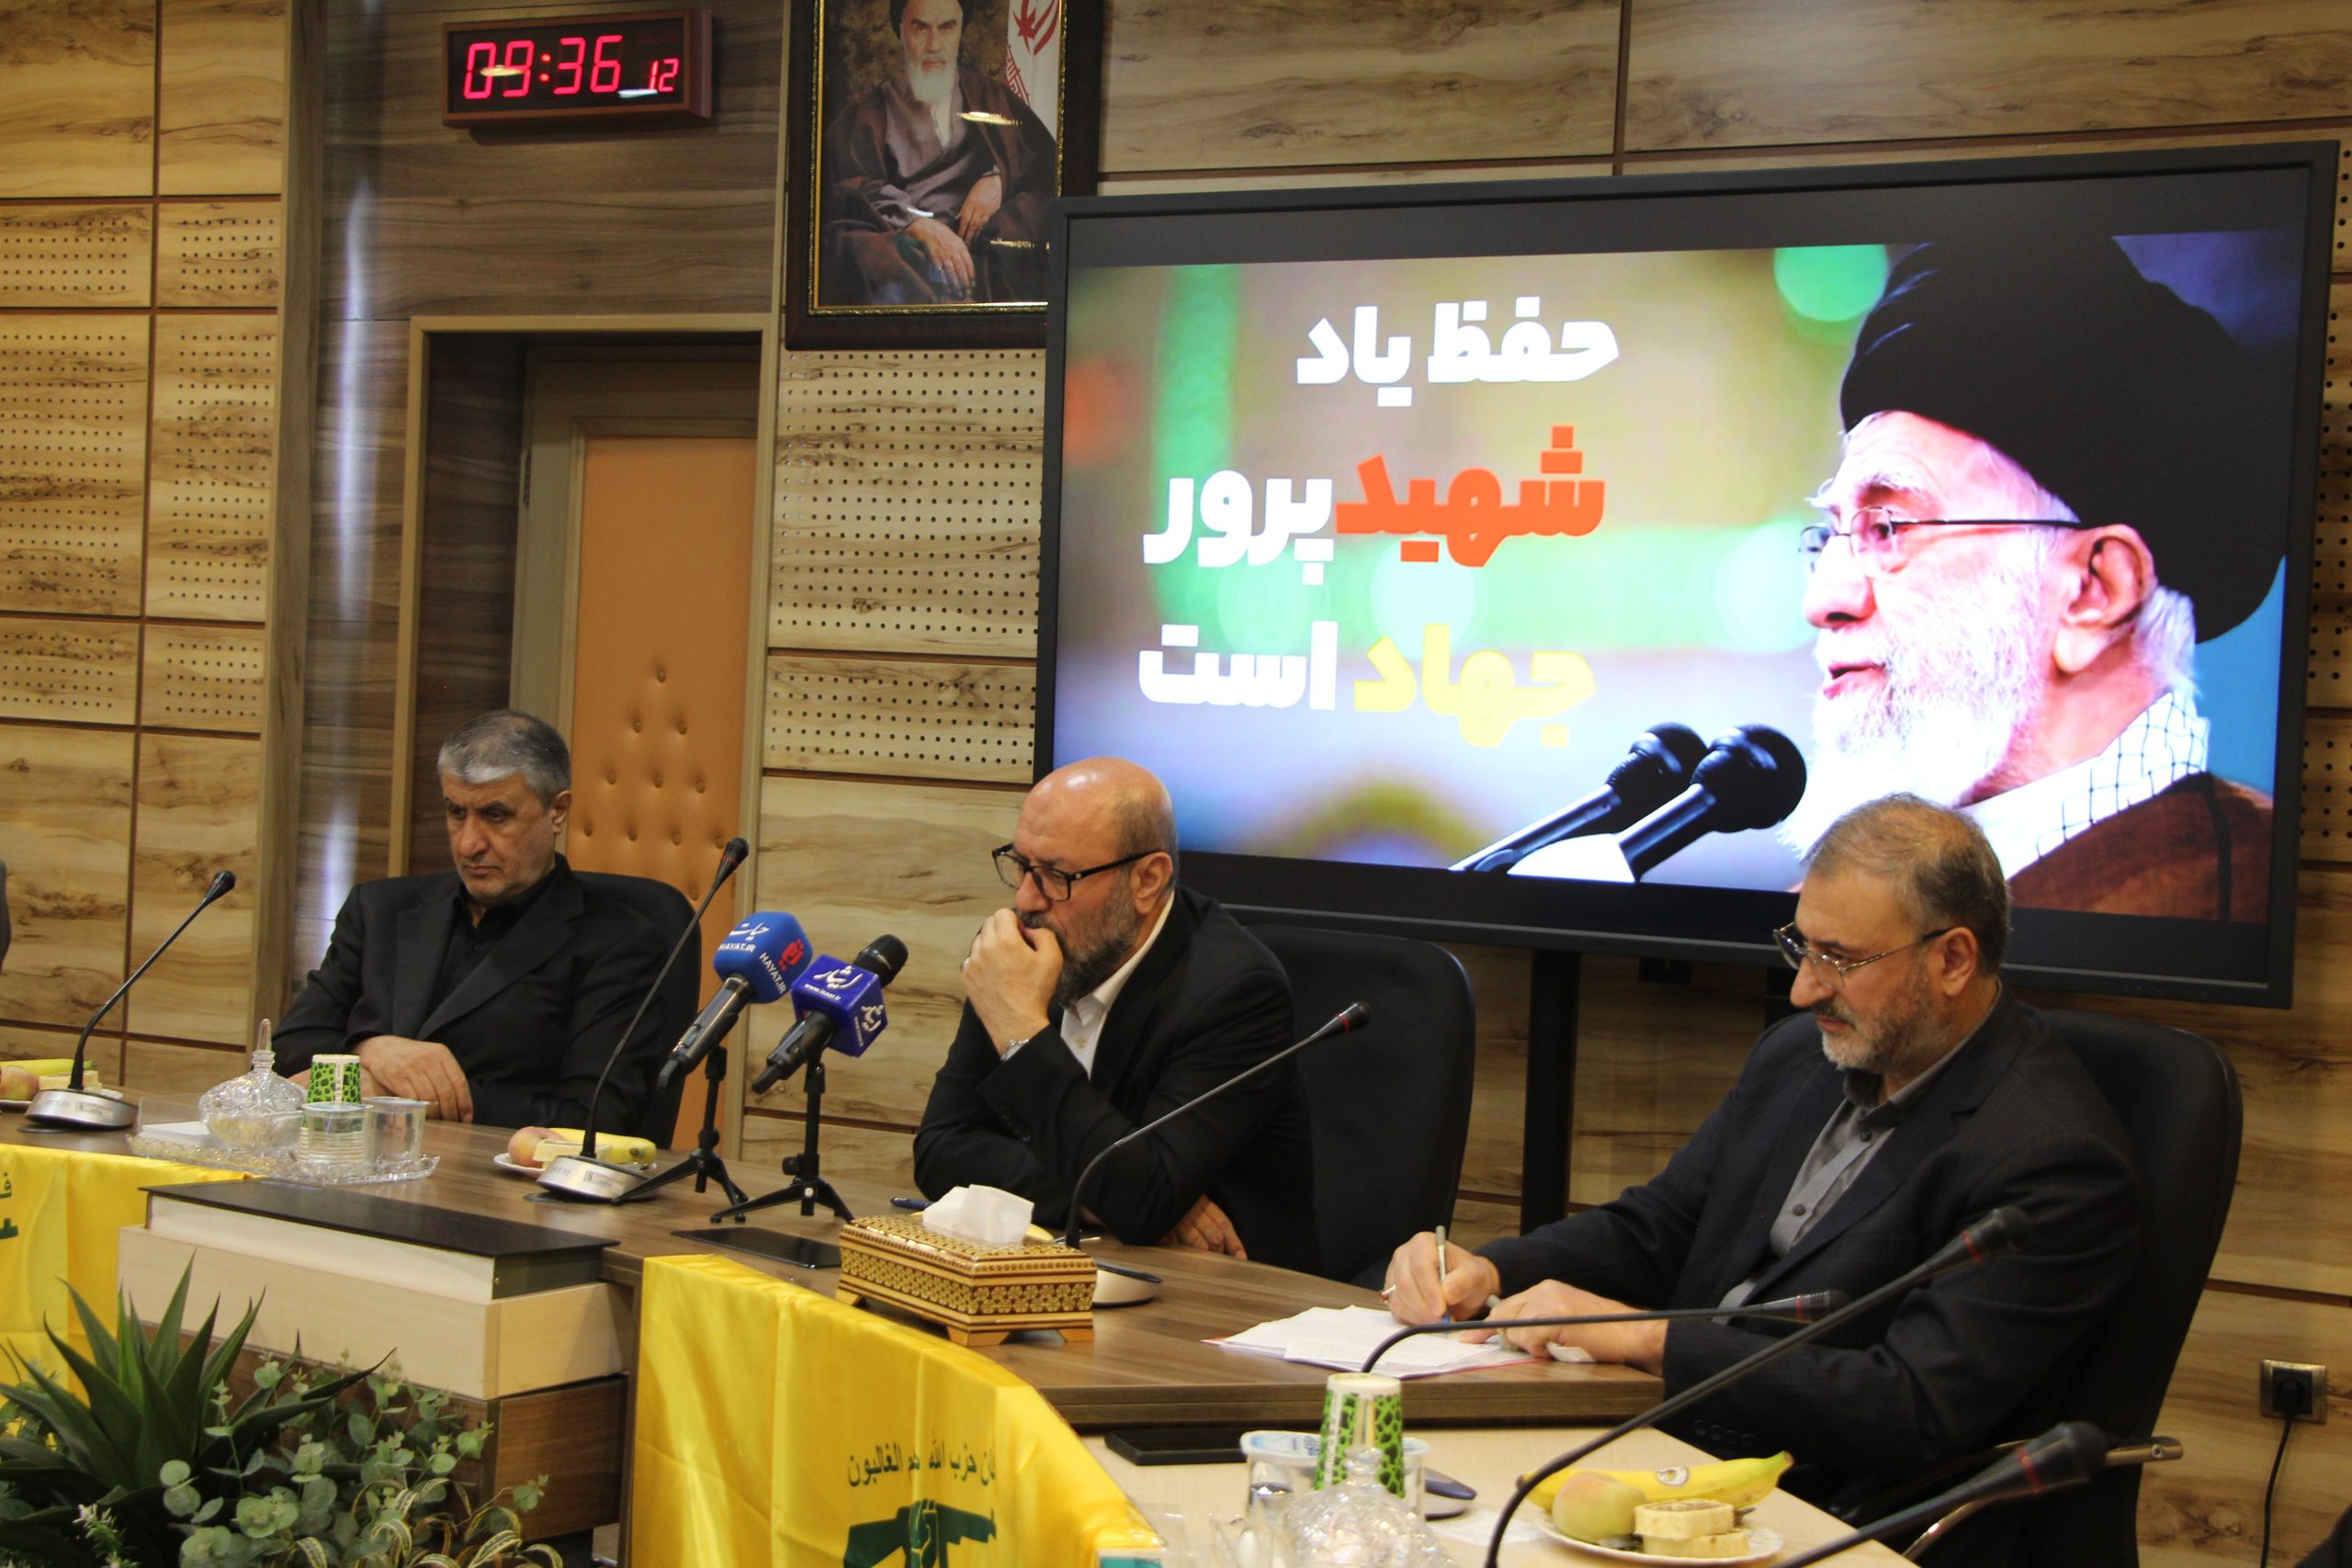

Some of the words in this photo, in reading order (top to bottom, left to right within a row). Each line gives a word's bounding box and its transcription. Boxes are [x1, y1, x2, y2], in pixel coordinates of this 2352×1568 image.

[463, 34, 623, 100] 09:36
[649, 58, 679, 93] 12
[1296, 306, 1412, 407] یاد
[1428, 296, 1619, 383] حفظ
[1139, 621, 1338, 711] است
[1353, 624, 1597, 749] جهاد
[718, 942, 756, 953] HAYAT.IR
[759, 952, 787, 994] HAYAT.IR
